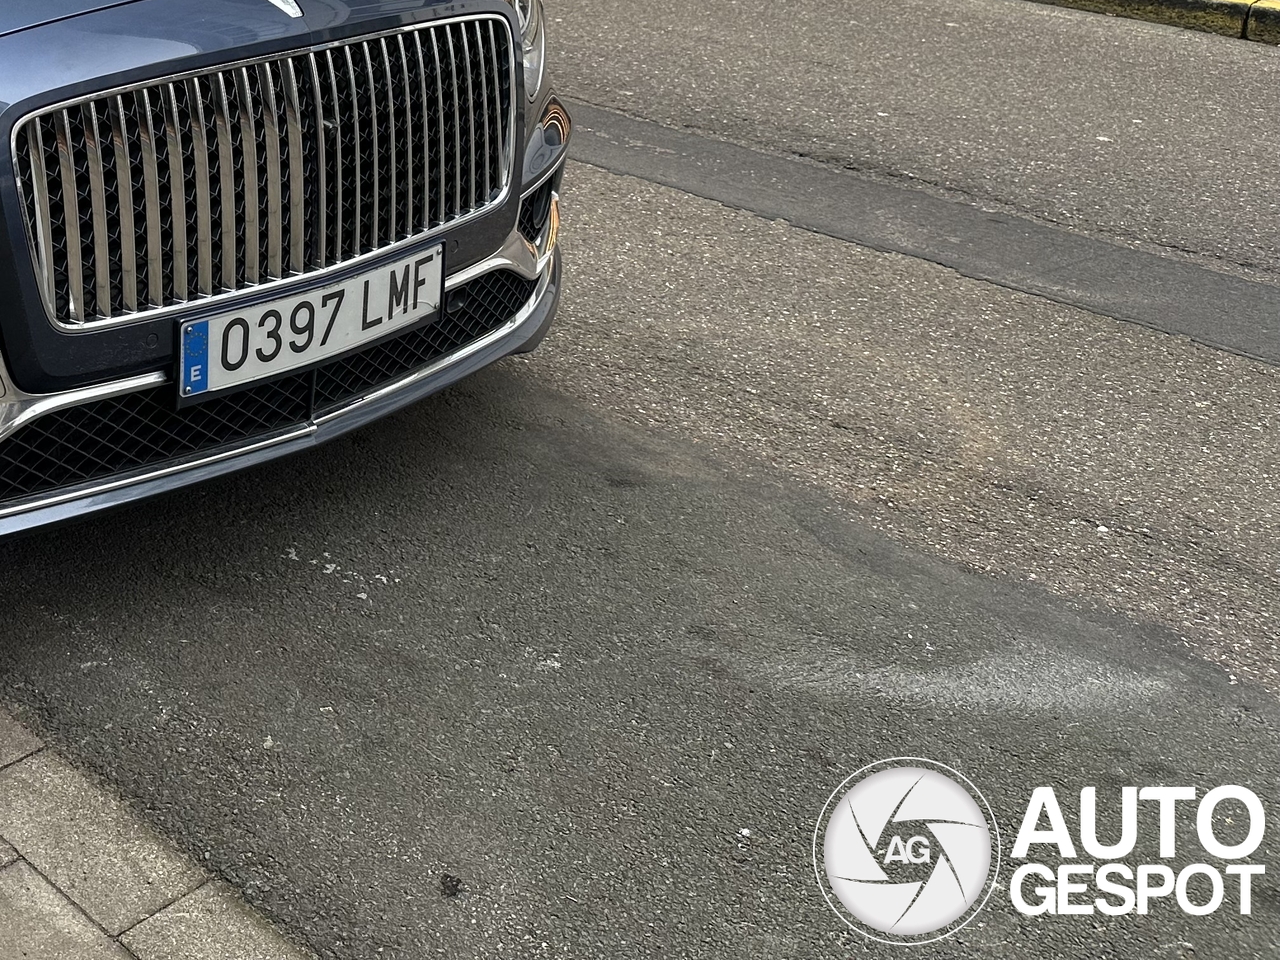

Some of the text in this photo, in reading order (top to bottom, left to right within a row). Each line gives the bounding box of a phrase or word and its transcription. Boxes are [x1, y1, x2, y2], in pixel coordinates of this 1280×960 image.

[220, 254, 434, 372] 0397 LMF
[190, 365, 202, 382] E
